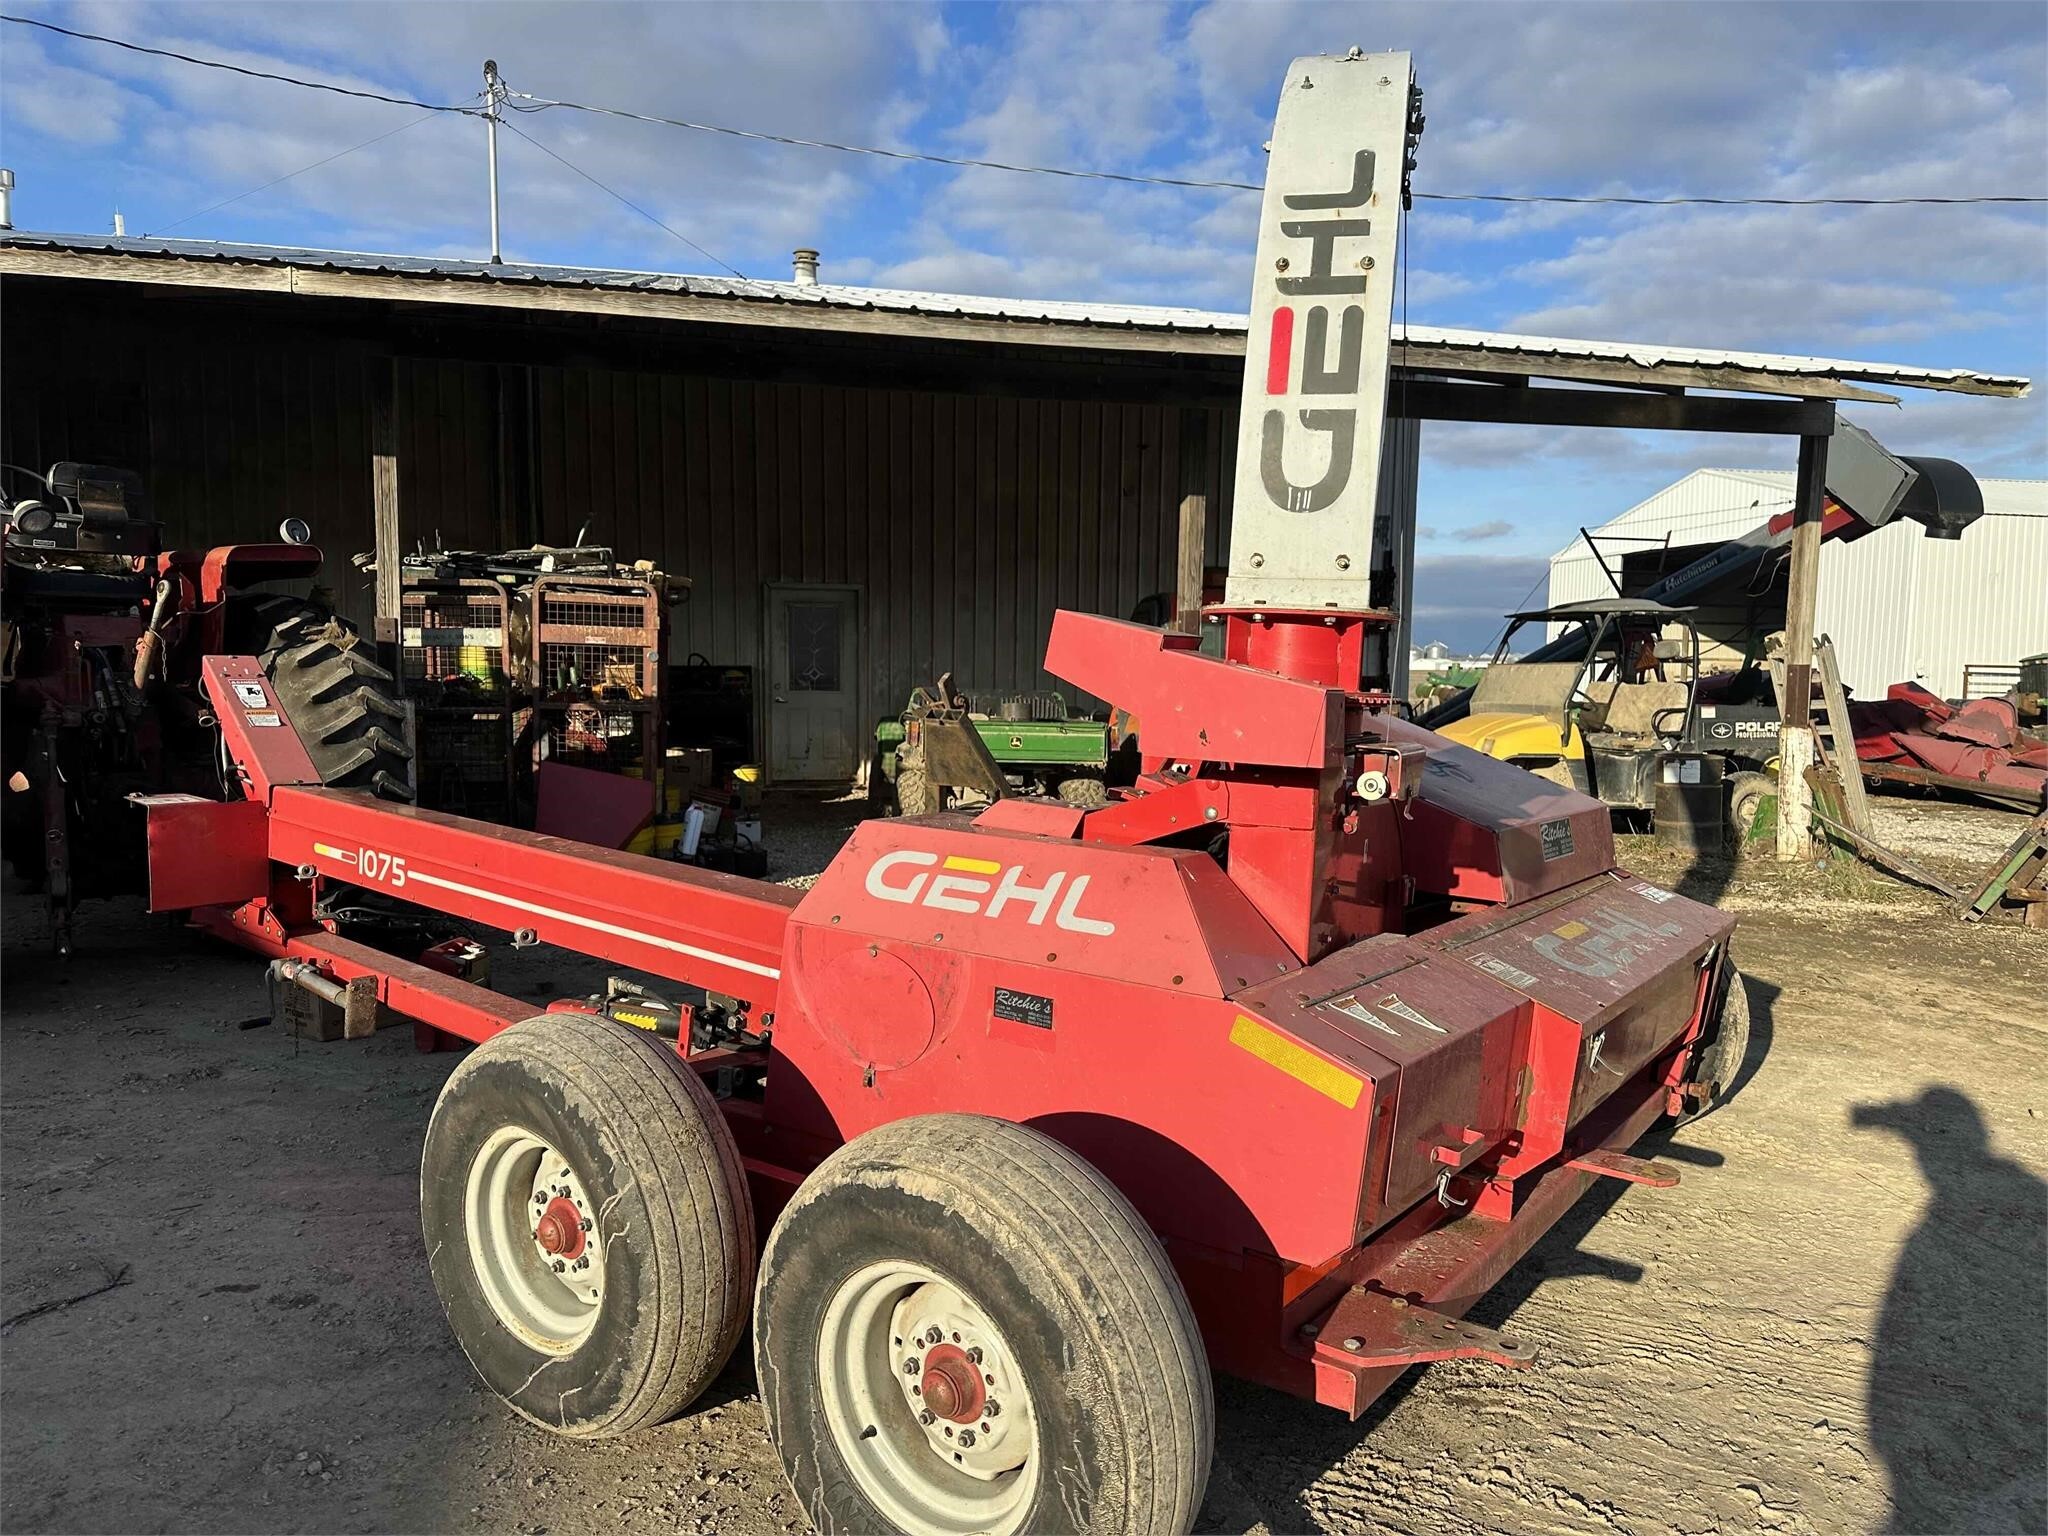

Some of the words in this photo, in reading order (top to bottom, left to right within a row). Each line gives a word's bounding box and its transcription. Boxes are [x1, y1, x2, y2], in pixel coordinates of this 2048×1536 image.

[1260, 149, 1376, 513] GEHL
[1665, 558, 1718, 591] Hutchinson
[1735, 721, 1781, 732] POLAR
[358, 847, 406, 887] 1075
[864, 850, 1116, 937] GEHL
[995, 989, 1052, 1014] Ritchie's
